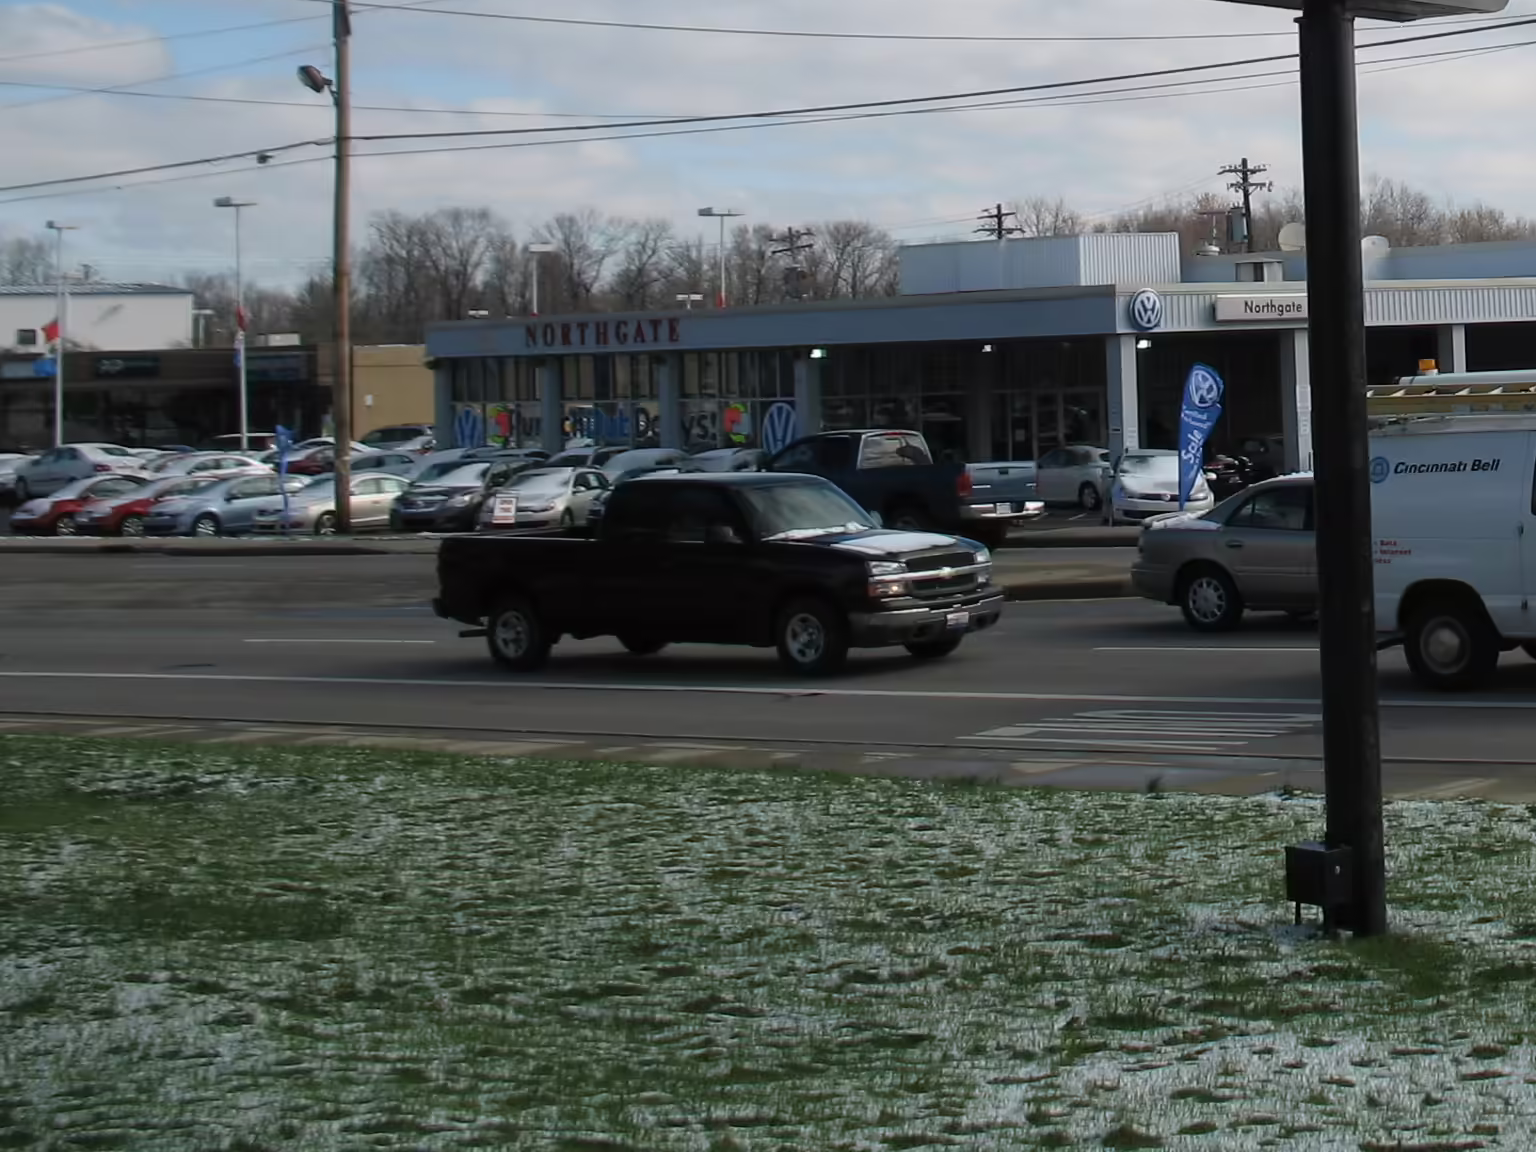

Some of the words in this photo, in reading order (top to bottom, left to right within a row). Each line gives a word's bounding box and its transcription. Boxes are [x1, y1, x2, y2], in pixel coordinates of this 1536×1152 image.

[1243, 299, 1303, 317] Northgate
[524, 318, 681, 348] NORTHGATE
[1181, 429, 1203, 465] Sale
[1393, 461, 1468, 475] Cincinnati
[1470, 458, 1501, 472] Bell
